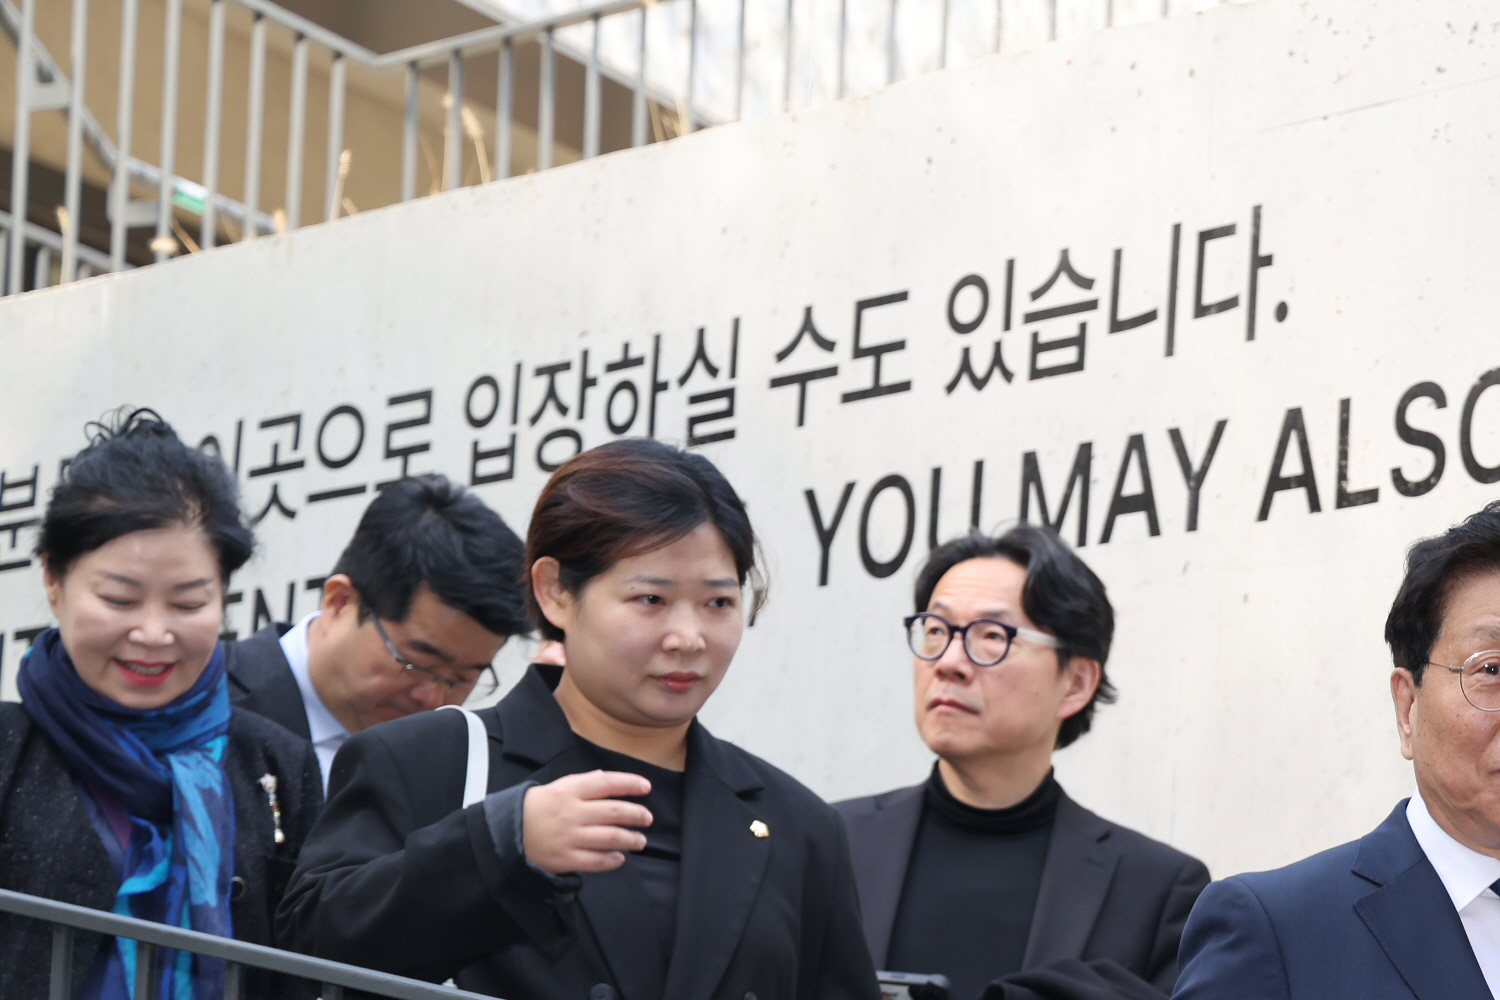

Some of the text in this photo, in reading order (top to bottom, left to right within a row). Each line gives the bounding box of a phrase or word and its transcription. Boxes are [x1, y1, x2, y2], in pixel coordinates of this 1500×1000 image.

[464, 316, 741, 488] 입장하실
[768, 290, 913, 428] 수도
[944, 204, 1290, 396] 있습니다.
[803, 459, 985, 587] YOU
[1018, 419, 1229, 548] MAY
